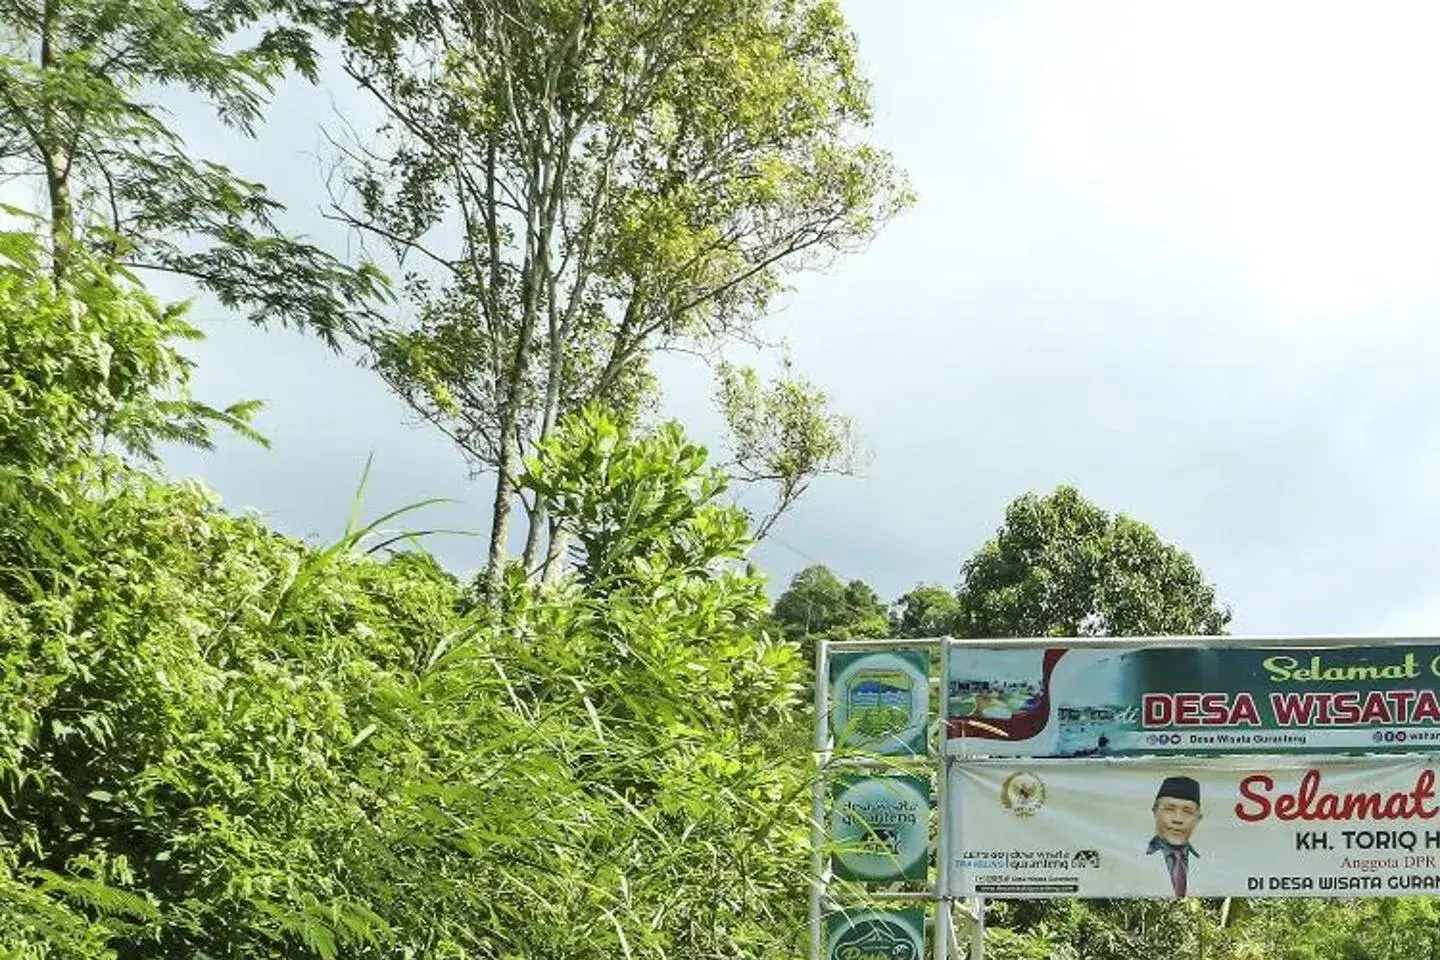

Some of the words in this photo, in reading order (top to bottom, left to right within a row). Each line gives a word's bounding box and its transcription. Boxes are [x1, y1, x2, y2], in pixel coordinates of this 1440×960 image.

[1261, 652, 1419, 684] Selamat
[1142, 692, 1262, 728] DESA
[1234, 769, 1440, 822] Selamat
[1295, 832, 1335, 851] KH.
[1342, 831, 1418, 852] TORIQ
[1340, 855, 1401, 873] Anggota
[1404, 855, 1437, 869] DPR
[1247, 876, 1265, 891] DI
[1268, 876, 1312, 891] DESA
[1318, 875, 1382, 890] WISATA
